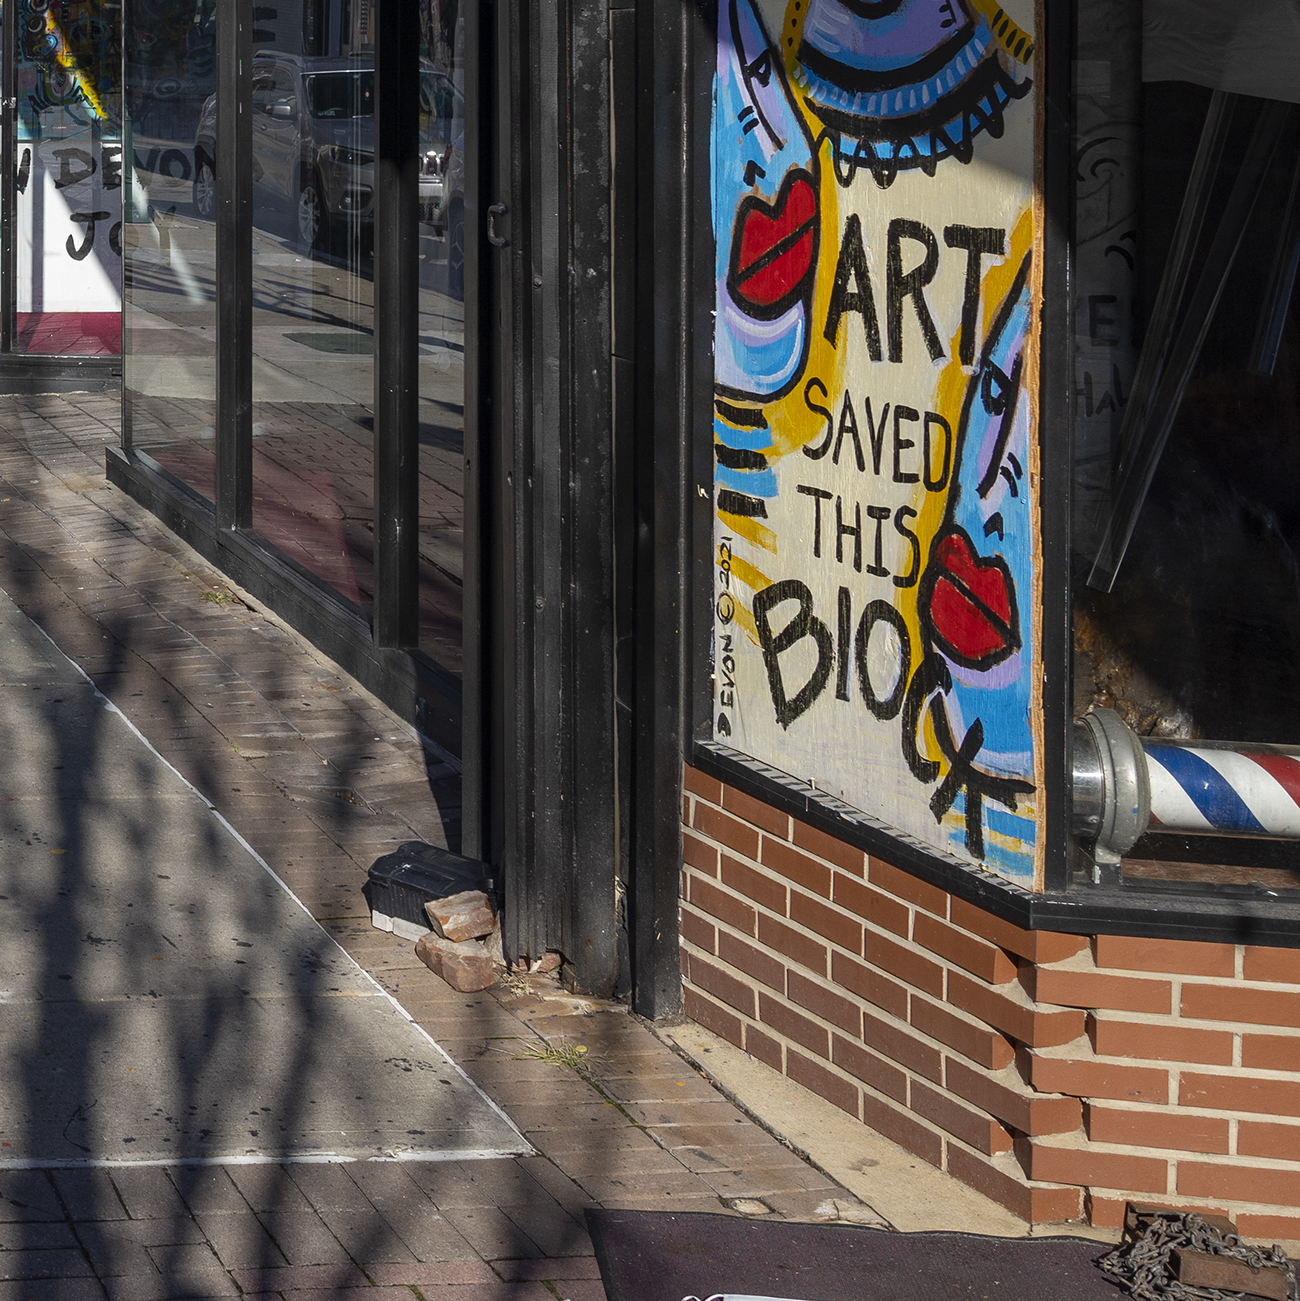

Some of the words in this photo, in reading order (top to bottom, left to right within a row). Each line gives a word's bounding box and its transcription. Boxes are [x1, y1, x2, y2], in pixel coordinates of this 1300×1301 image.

[821, 213, 1006, 369] ART
[801, 376, 952, 494] SAVED
[797, 484, 921, 589] THIS
